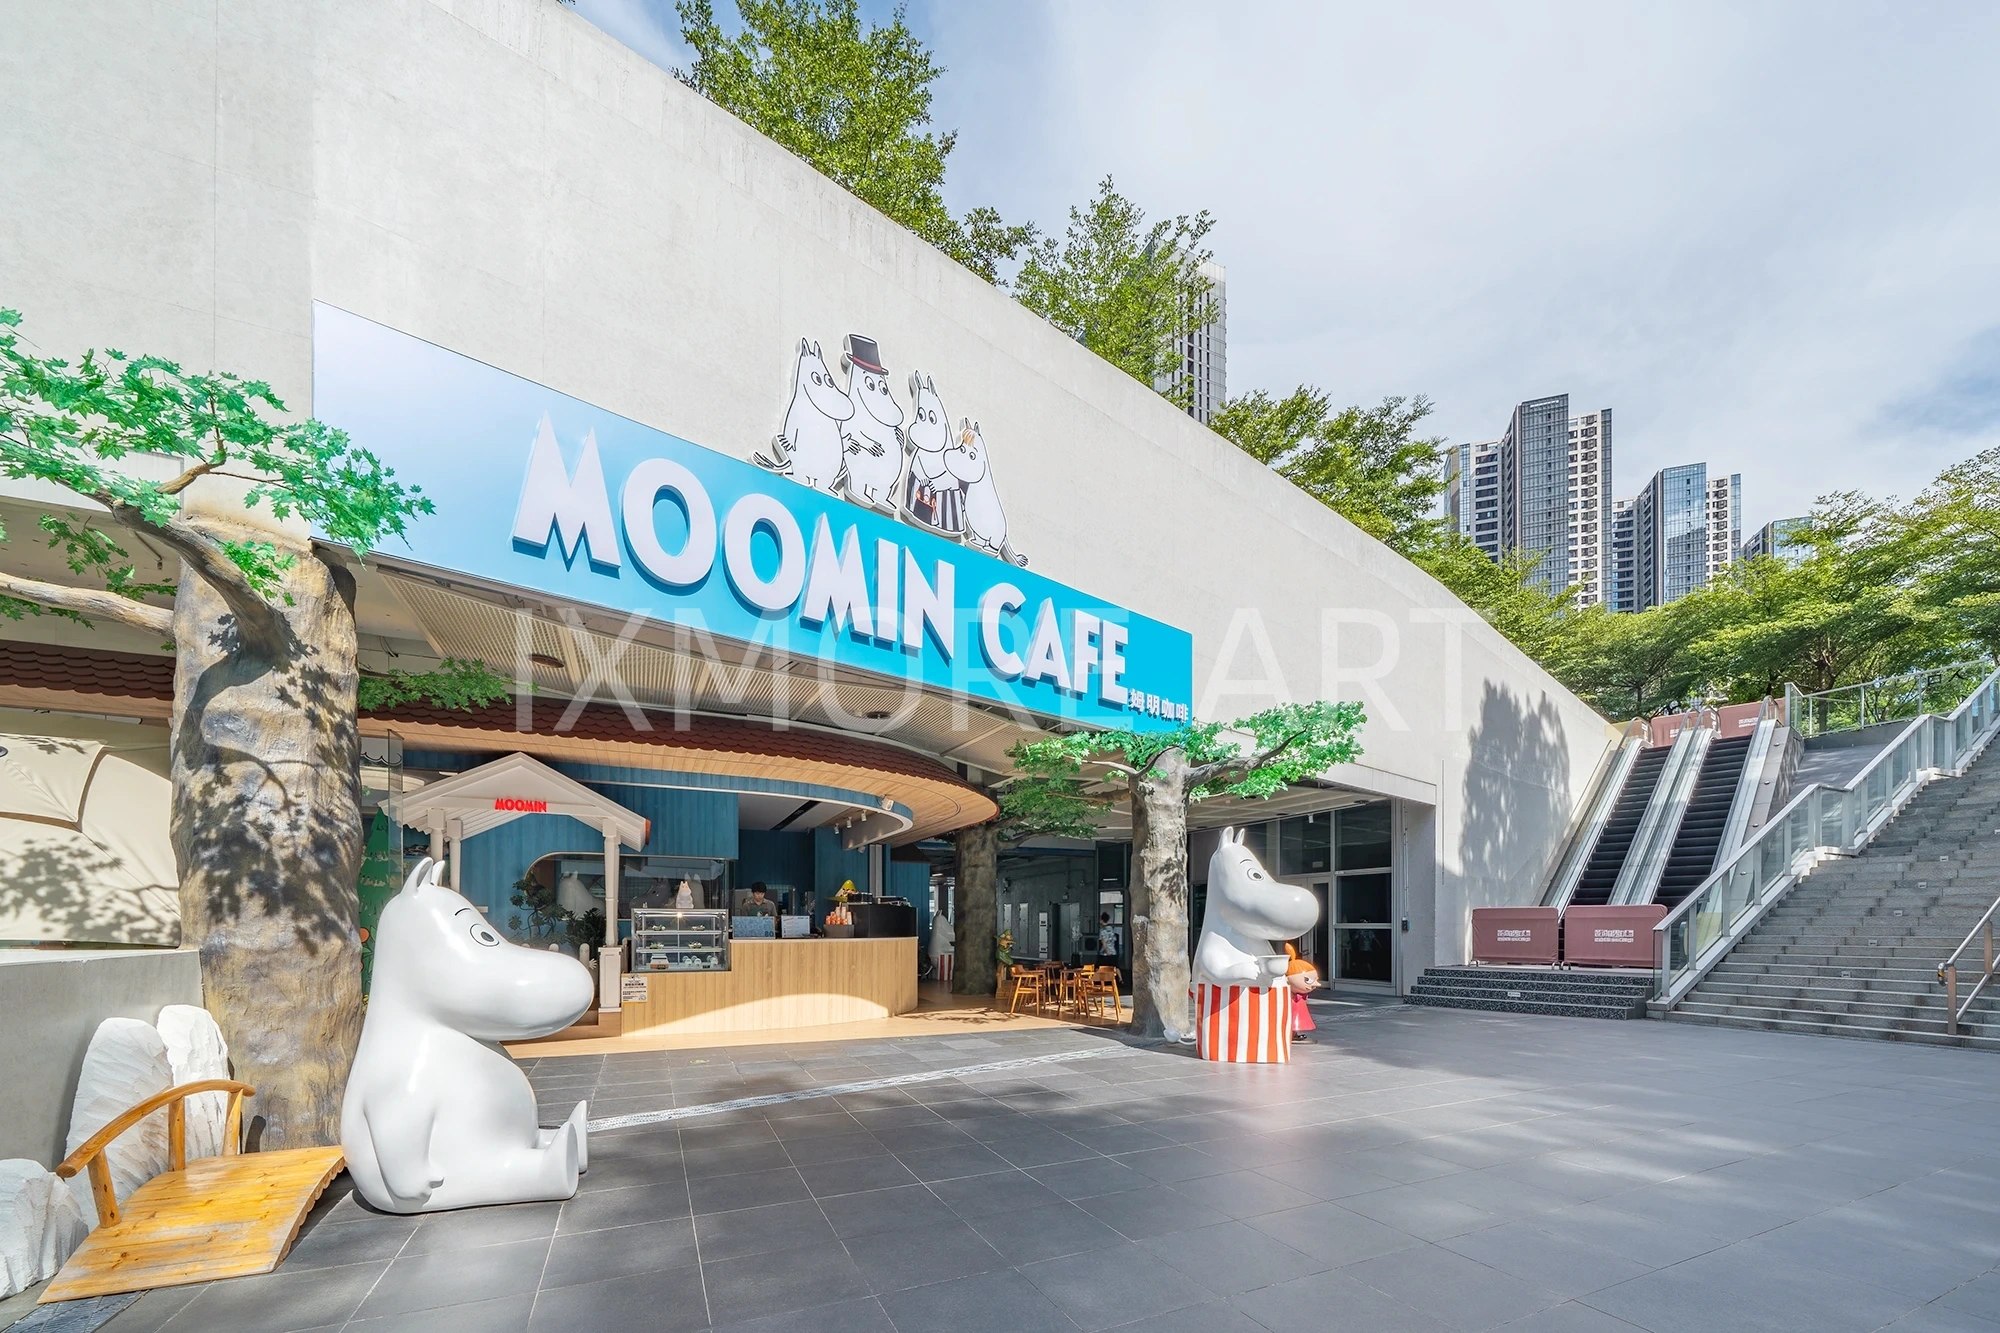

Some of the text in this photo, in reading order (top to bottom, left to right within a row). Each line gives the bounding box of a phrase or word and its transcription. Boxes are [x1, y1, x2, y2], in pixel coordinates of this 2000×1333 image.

[513, 410, 1128, 706] MOOMIN CAFE
[1128, 688, 1189, 723] 姆明咖啡
[494, 798, 547, 812] MOOMIN
